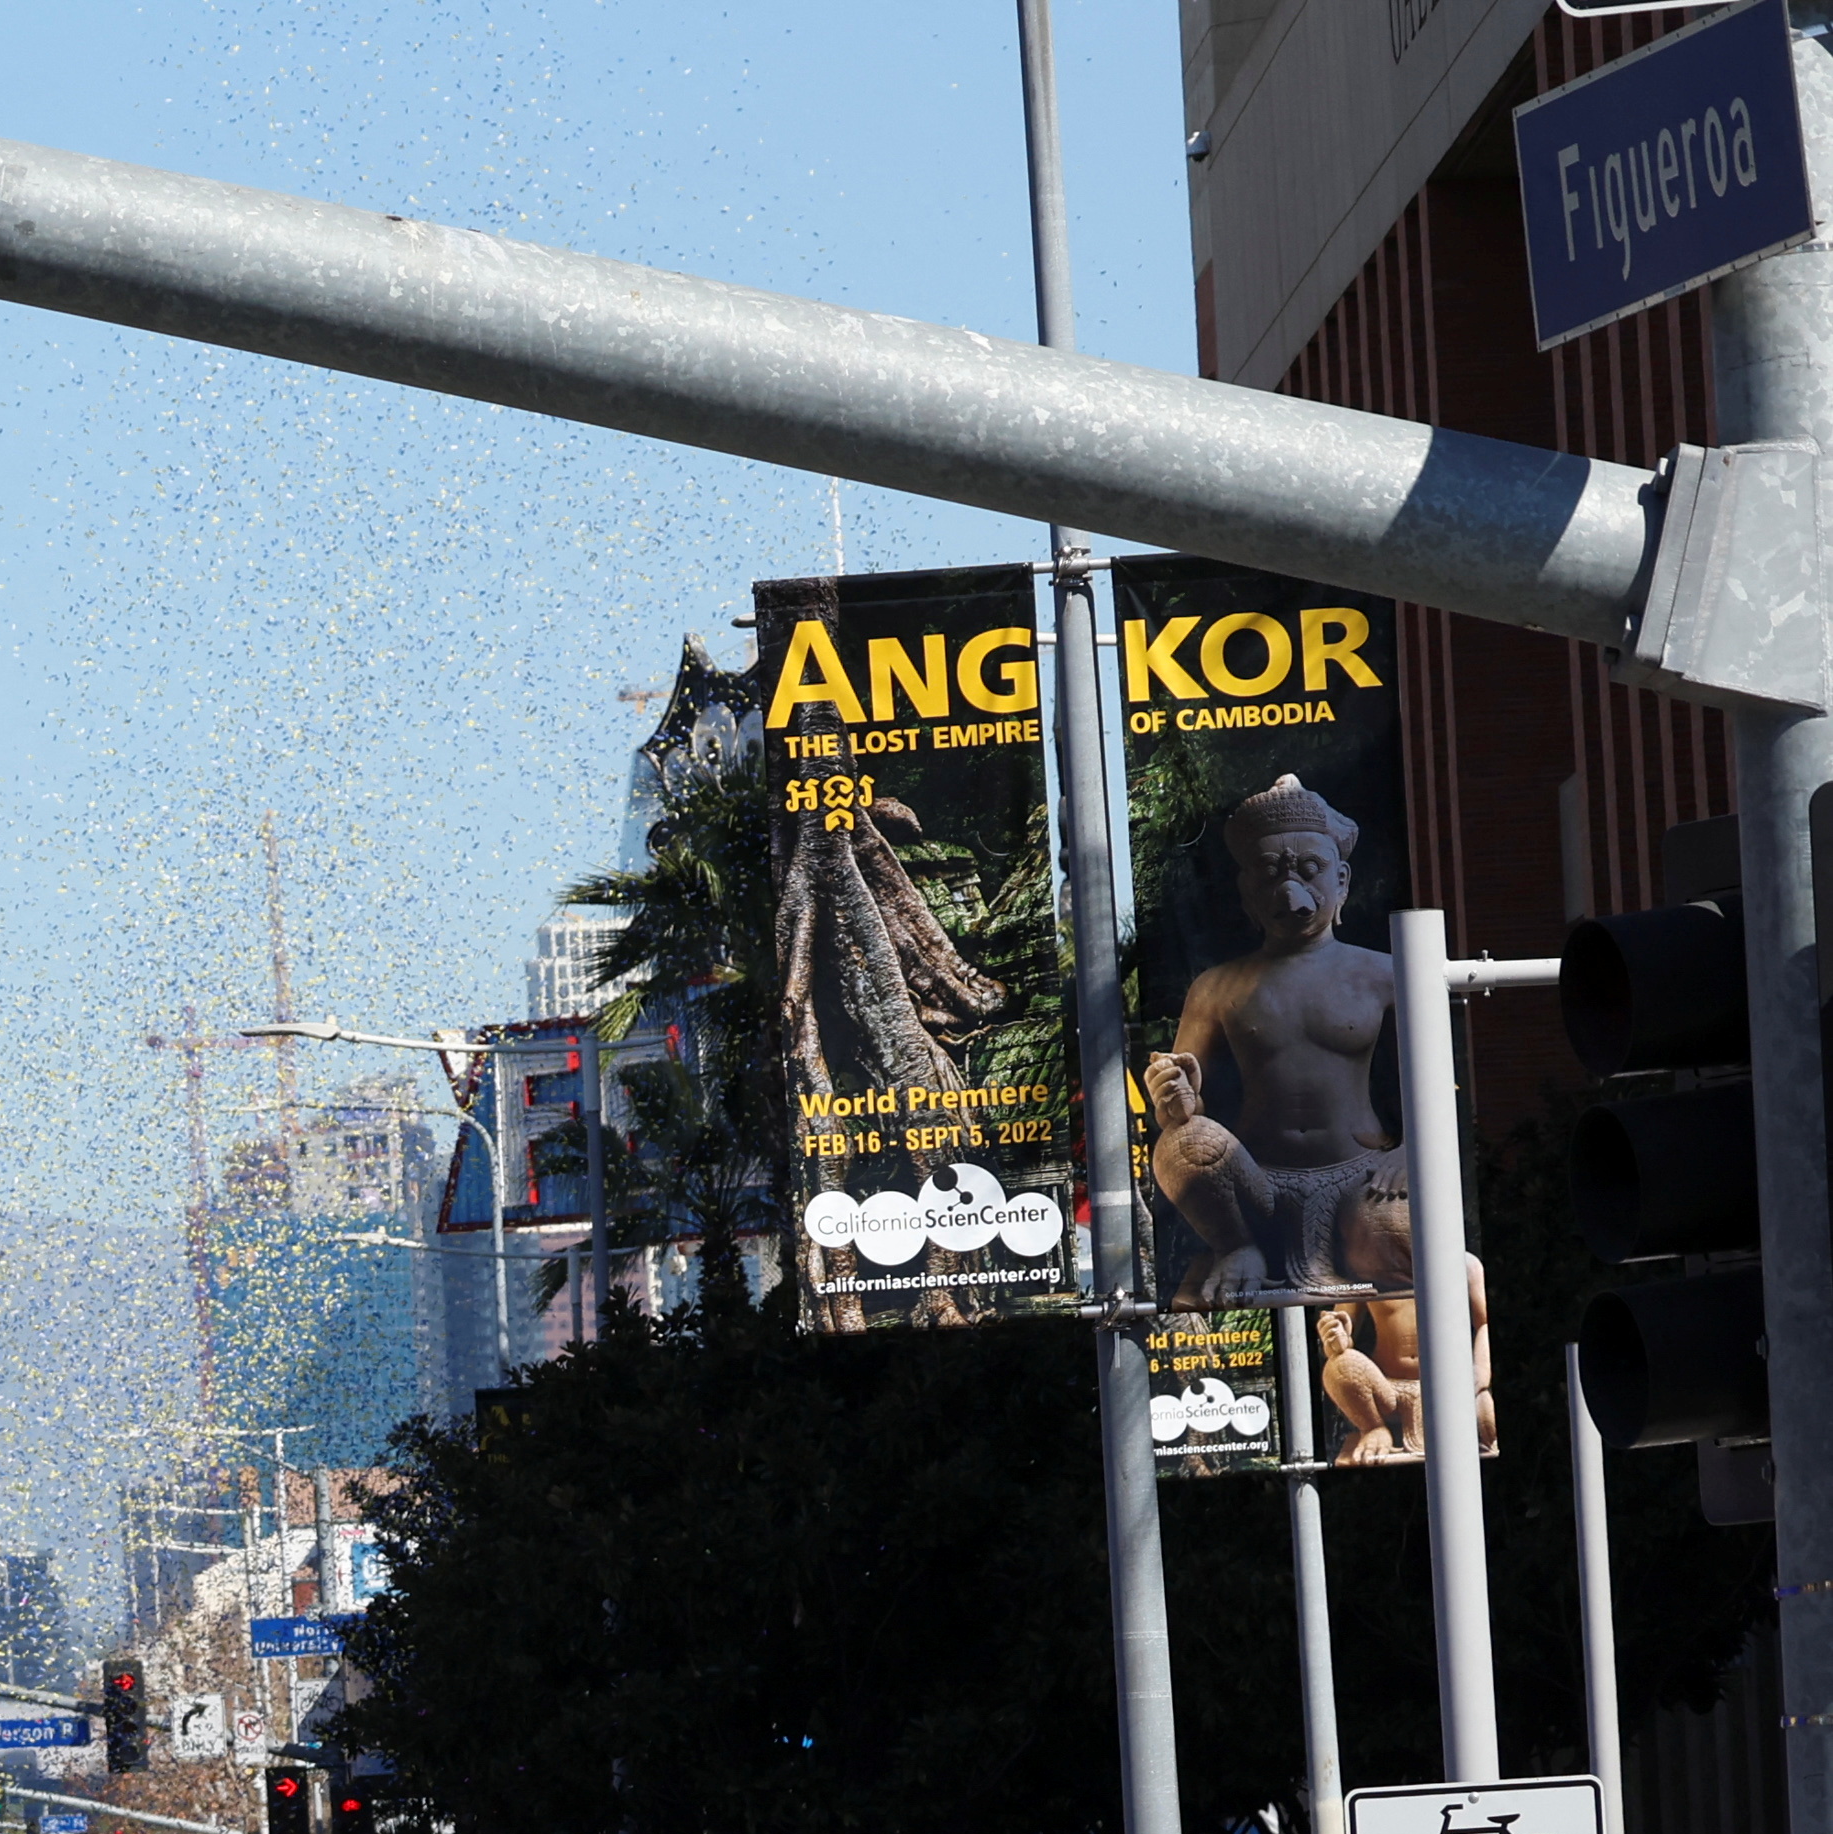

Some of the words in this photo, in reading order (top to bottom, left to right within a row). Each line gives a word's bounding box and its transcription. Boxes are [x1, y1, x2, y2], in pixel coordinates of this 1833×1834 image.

[1558, 97, 1757, 281] Figueroa
[766, 619, 1038, 729] ANG
[1126, 607, 1384, 705] KOR
[1130, 709, 1169, 735] OF
[1174, 701, 1336, 732] CAMBODIA
[784, 732, 838, 759] THE
[850, 726, 918, 756] LOST
[933, 718, 1041, 751] EMPIRE
[799, 1086, 897, 1119] World
[908, 1080, 1049, 1112] Premiere
[804, 1132, 848, 1157] FEB
[854, 1130, 880, 1154] 16
[906, 1125, 960, 1152] SEPT
[965, 1123, 992, 1150] 5,
[998, 1119, 1053, 1145] 2022
[816, 1264, 1061, 1295] californiasciencecenter.org
[1174, 1328, 1261, 1348] Premiere
[1173, 1355, 1207, 1372] SEPT
[1229, 1352, 1264, 1368] 2022
